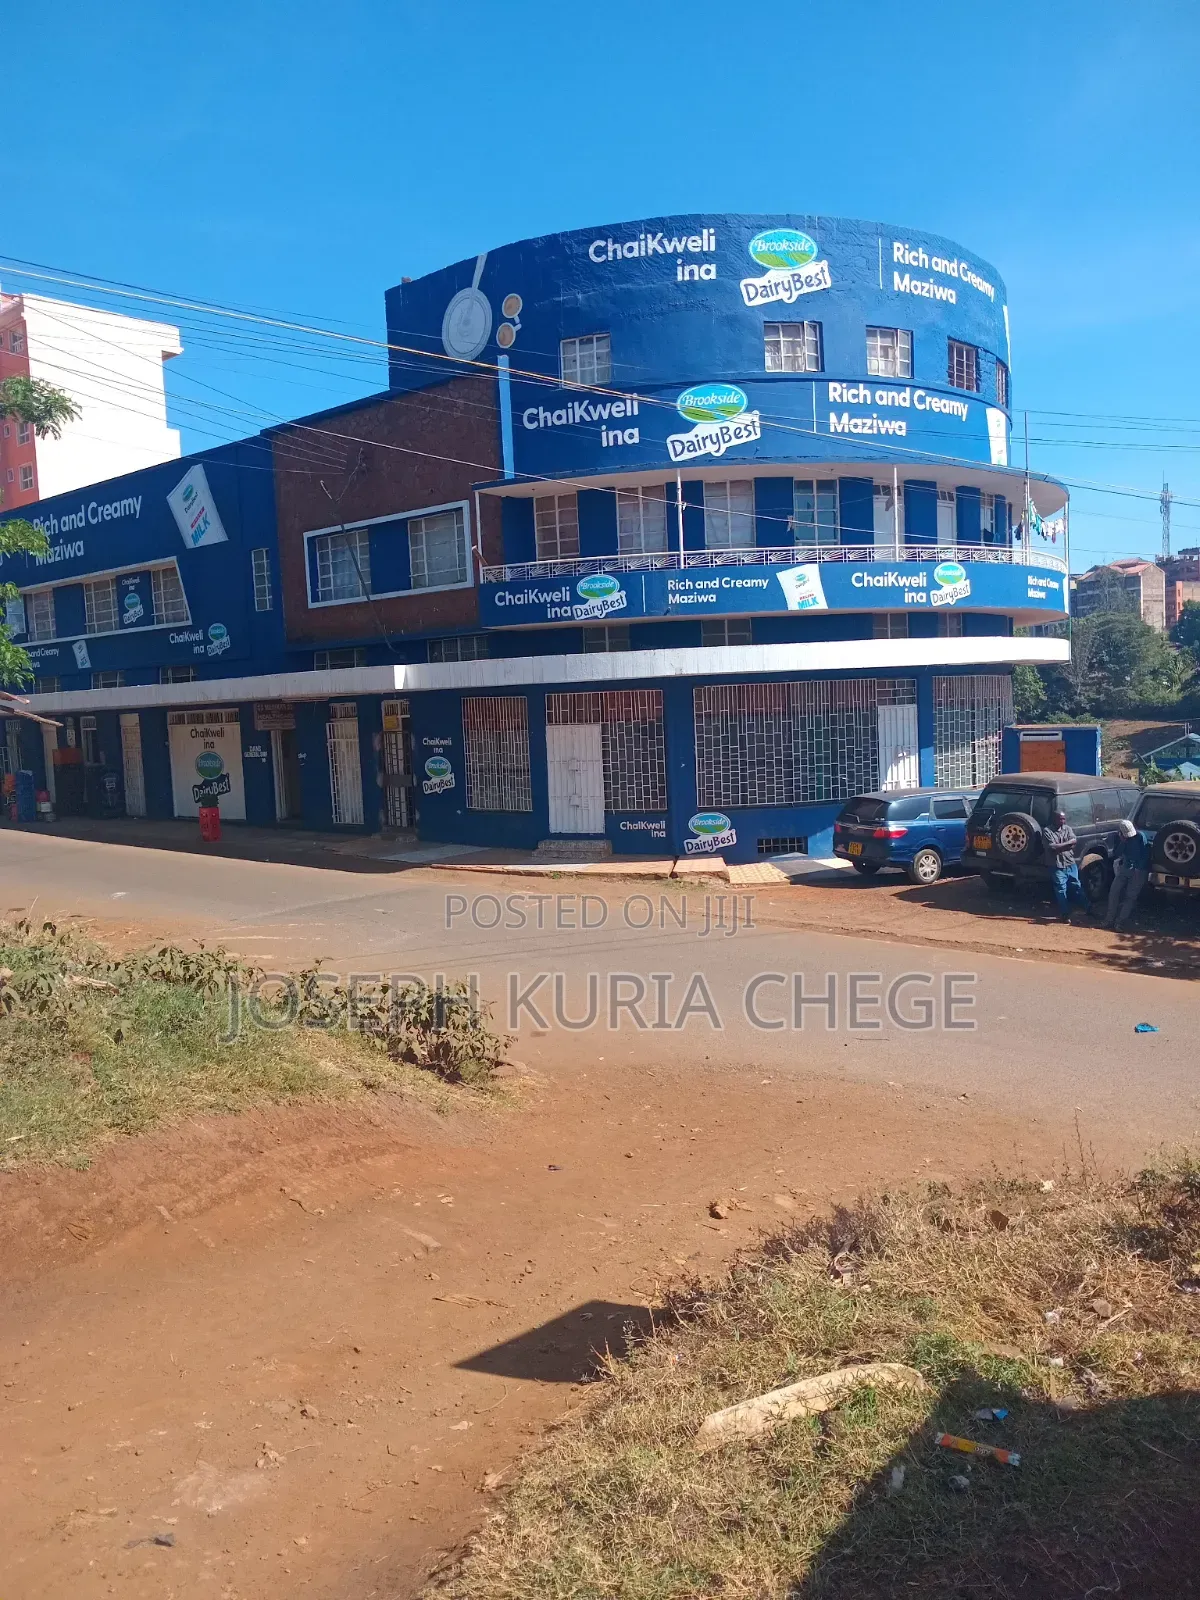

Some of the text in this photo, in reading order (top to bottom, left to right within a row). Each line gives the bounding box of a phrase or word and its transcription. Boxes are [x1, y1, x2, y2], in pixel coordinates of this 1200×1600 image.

[588, 228, 716, 263] ChaiKweli
[755, 239, 812, 252] Brookside
[677, 259, 717, 282] ina
[893, 241, 995, 303] Rich and Creamy
[744, 265, 829, 302] DairyBest
[893, 271, 956, 304] Maziwa
[682, 392, 742, 407] Brookside
[828, 381, 969, 422] Rich and Creamy
[522, 393, 639, 430] ChaiKweli
[829, 411, 907, 436] Maziwa
[601, 424, 640, 447] ina
[669, 419, 759, 458] DairyBest
[60, 504, 86, 532] and
[87, 495, 142, 526] Creamy
[667, 577, 770, 591] Rich and Creamy
[851, 571, 927, 588] ChaiKweli
[494, 587, 571, 607] ChaiKweli
[668, 592, 717, 605] Maziwa
[904, 588, 927, 604] ina
[931, 583, 970, 604] DairyBest
[547, 603, 572, 618] ina
[574, 594, 626, 619] DairyBest
[797, 596, 820, 610] MILK
[169, 629, 204, 644] ChaiKweli
[192, 643, 205, 654] ina
[190, 727, 225, 739] ChaiKweli
[203, 739, 215, 749] ina
[422, 738, 452, 746] ChaiKweli
[424, 776, 454, 792] DairyBest
[620, 820, 666, 831] ChaiKweli
[692, 817, 726, 827] Brookside
[651, 829, 667, 838] ina
[686, 832, 736, 852] DairyBest
